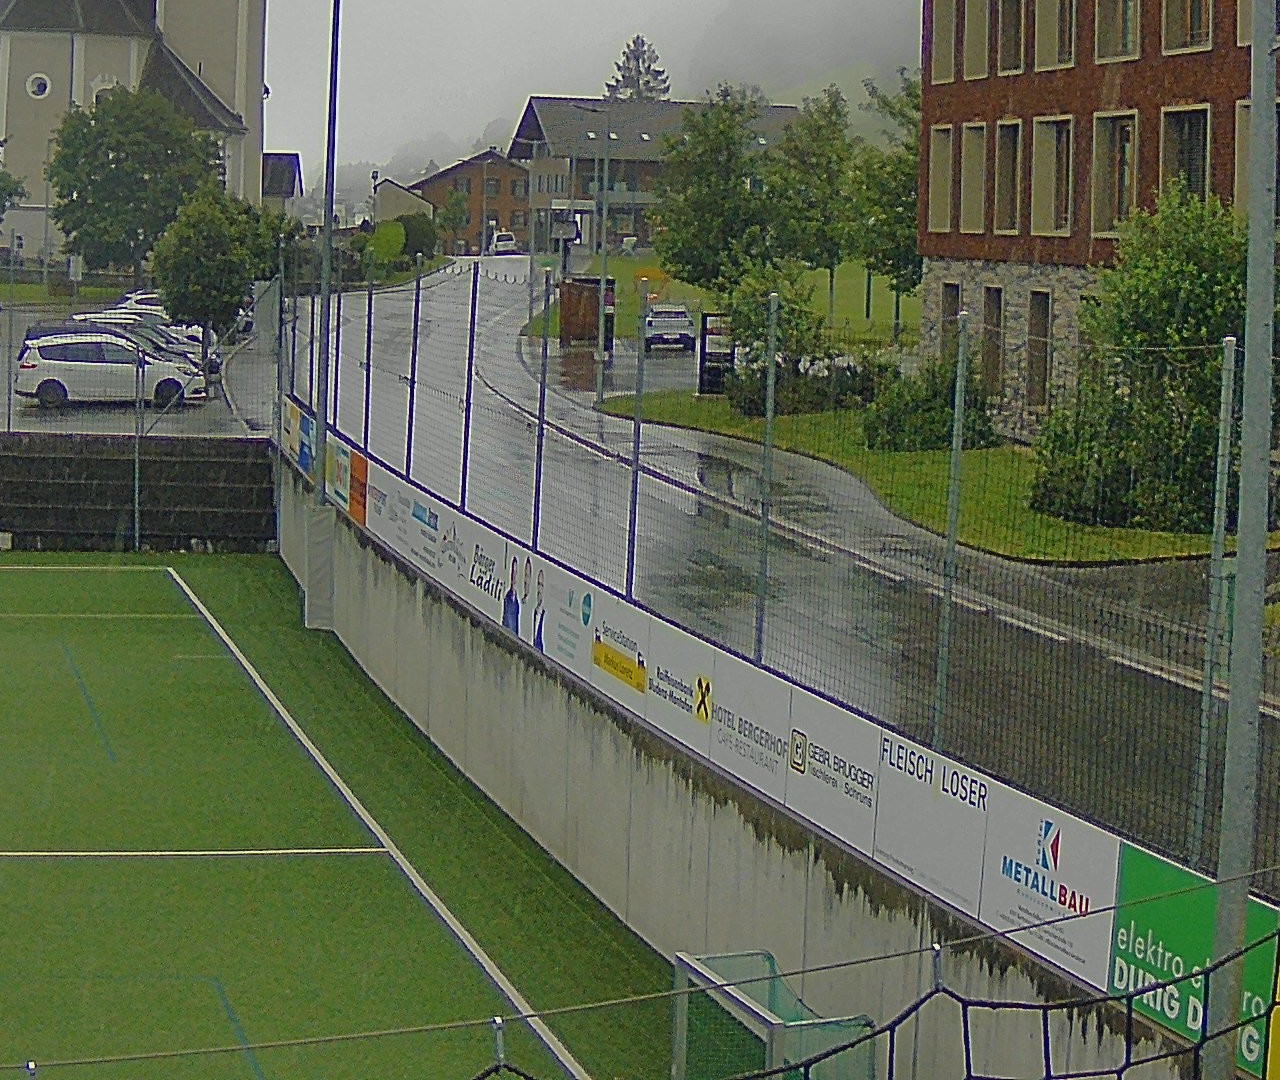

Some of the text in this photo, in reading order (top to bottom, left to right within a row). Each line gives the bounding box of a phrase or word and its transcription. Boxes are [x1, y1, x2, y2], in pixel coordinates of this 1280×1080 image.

[712, 702, 736, 731] HOTEL
[738, 717, 789, 759] BERGERHOF
[833, 755, 874, 791] BRUGGER
[882, 737, 988, 812] FLEISCH LOSER
[1001, 855, 1090, 917] METALLBAU
[1117, 919, 1184, 978] elektro
